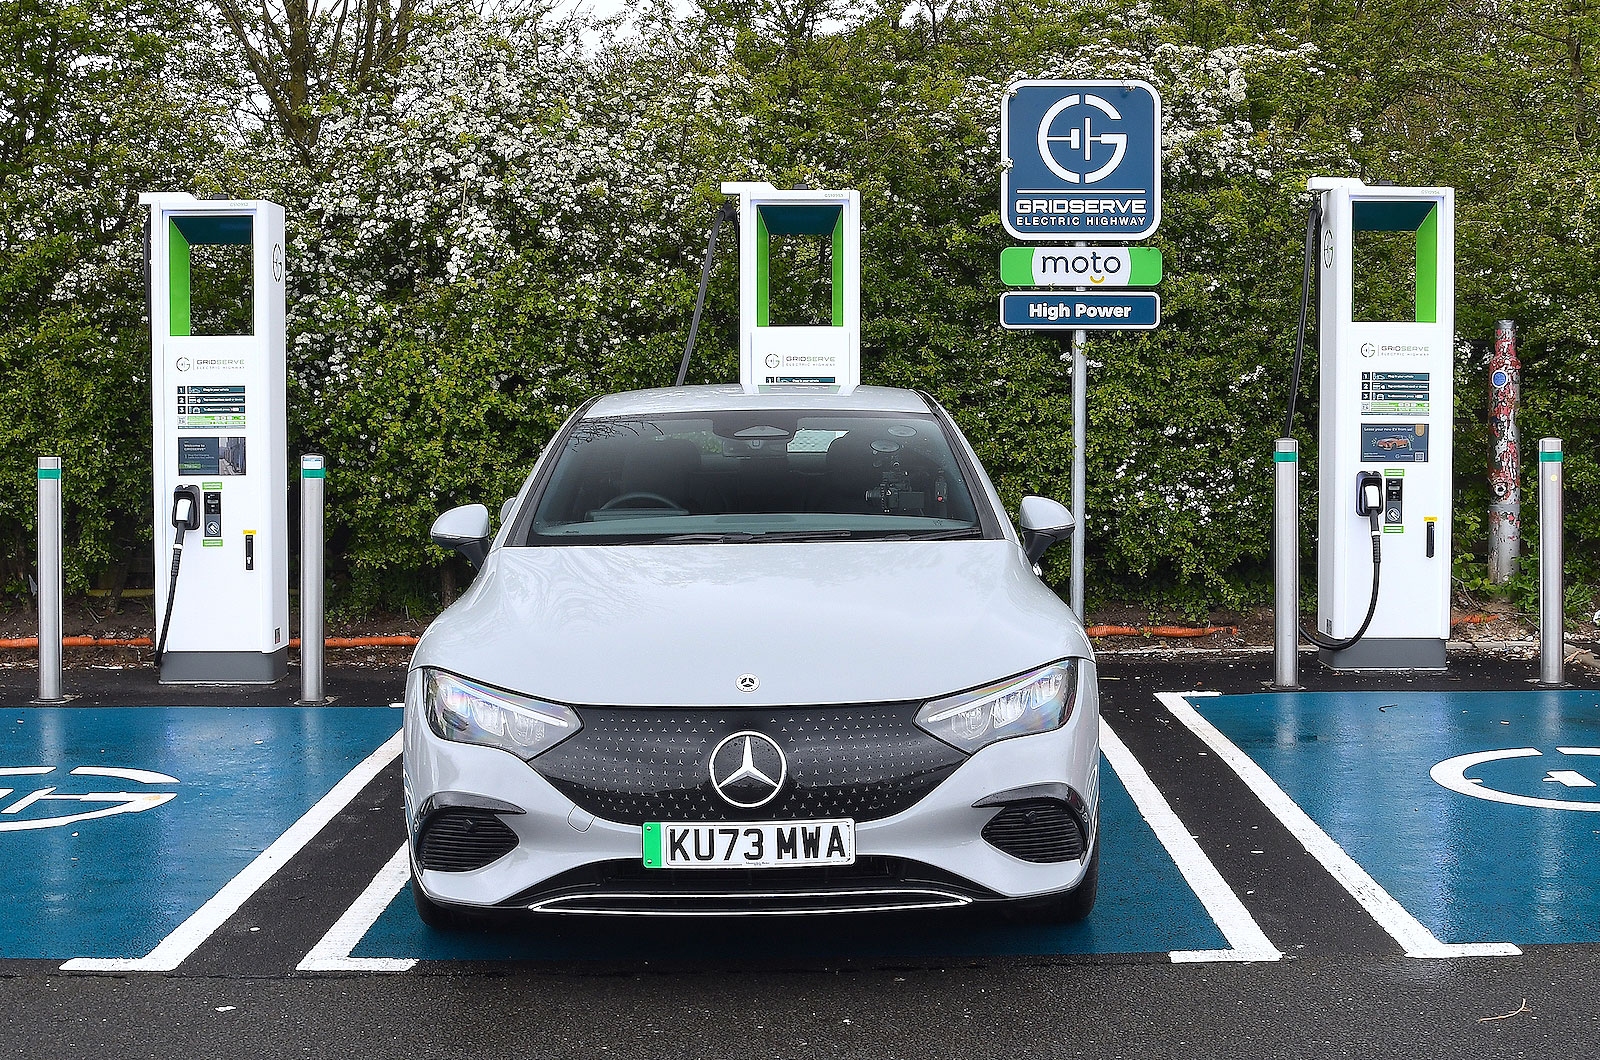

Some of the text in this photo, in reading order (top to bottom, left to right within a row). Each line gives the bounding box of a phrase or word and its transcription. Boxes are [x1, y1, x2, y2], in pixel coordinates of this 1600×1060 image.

[1015, 199, 1147, 214] GRIDSERVE
[1016, 216, 1146, 226] ELECTRIC HIGHWAY
[1041, 251, 1121, 274] moto
[1029, 302, 1132, 319] High Power
[669, 825, 846, 861] KU73 MWA
